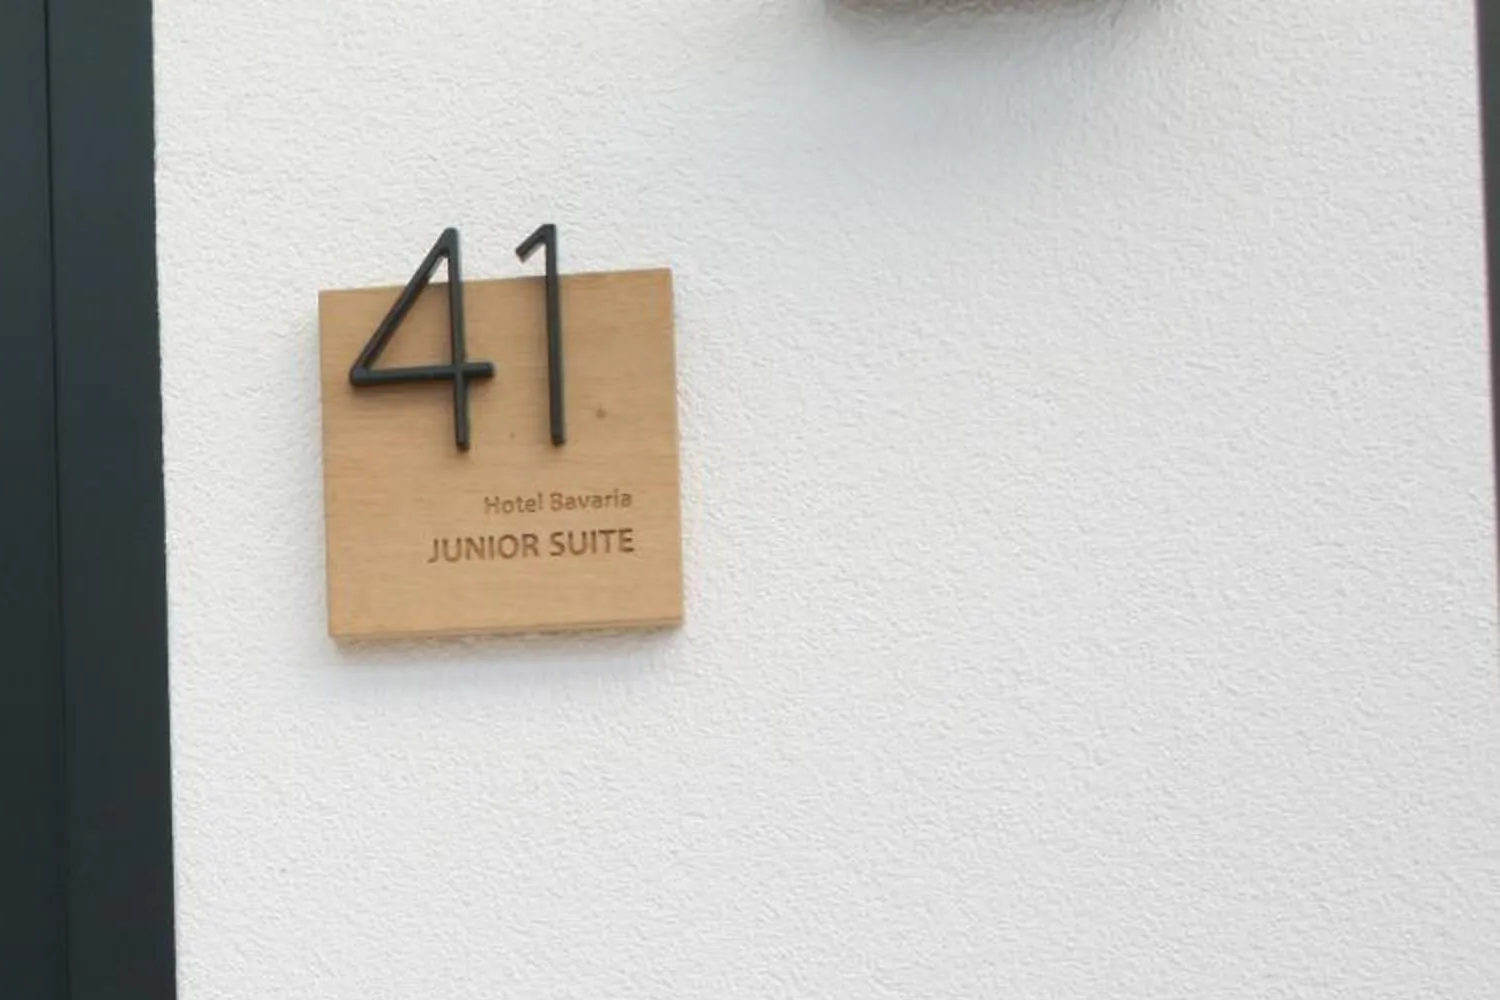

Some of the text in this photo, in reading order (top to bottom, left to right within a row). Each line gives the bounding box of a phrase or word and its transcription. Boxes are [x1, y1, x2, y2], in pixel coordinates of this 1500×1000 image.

[349, 224, 566, 452] 41
[484, 488, 633, 514] Hotel Bavaria
[427, 528, 635, 564] JUNIOR SUITE
